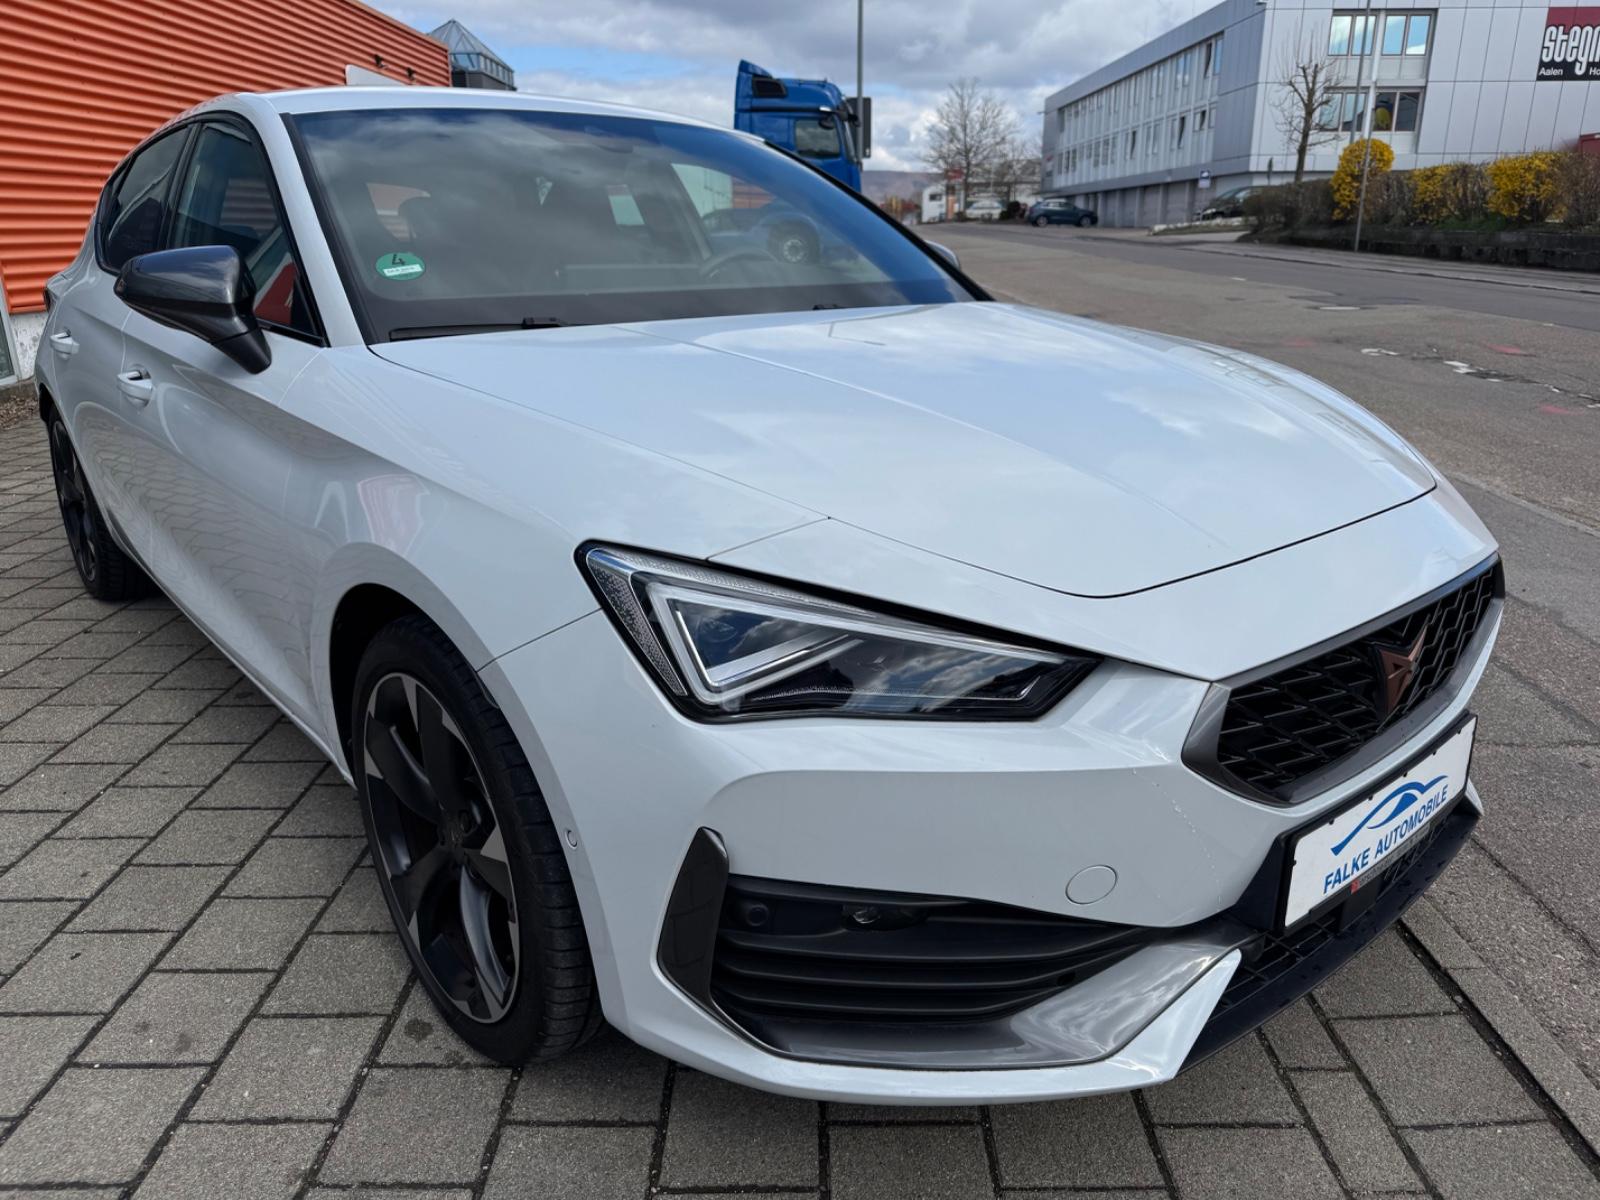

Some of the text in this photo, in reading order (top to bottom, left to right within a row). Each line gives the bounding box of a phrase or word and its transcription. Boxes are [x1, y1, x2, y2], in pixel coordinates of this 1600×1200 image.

[1539, 67, 1563, 75] Aalen
[392, 253, 405, 265] 4
[1323, 847, 1371, 894] FALKE
[1374, 784, 1448, 859] AUTOMOBILE
